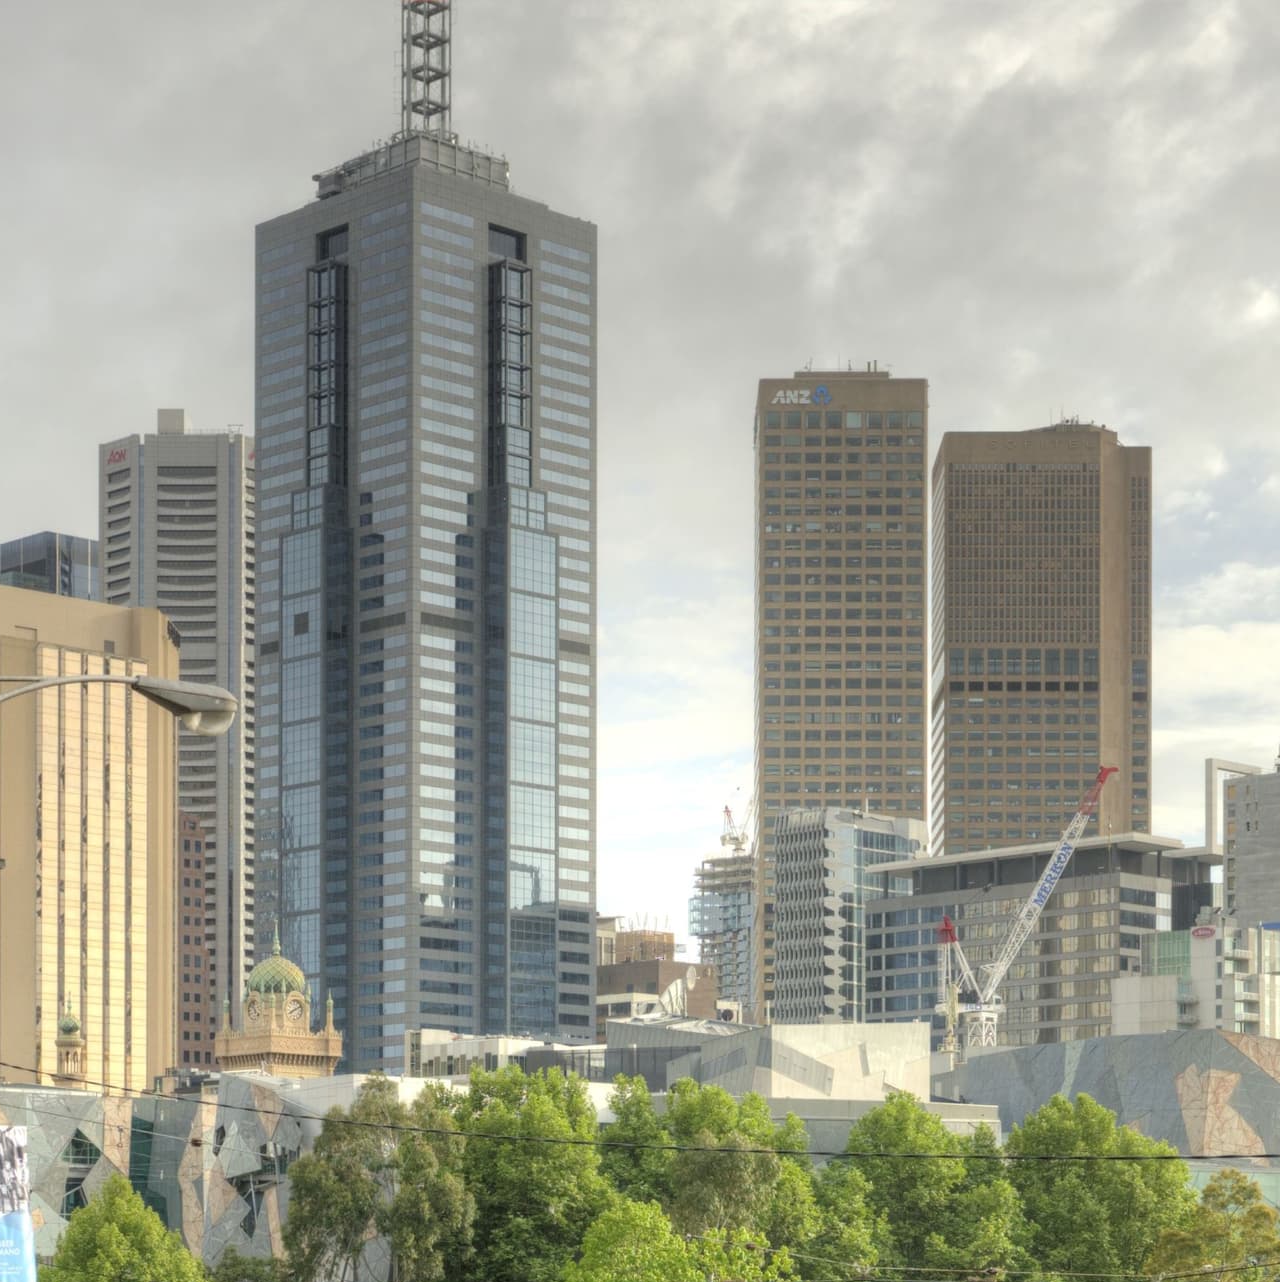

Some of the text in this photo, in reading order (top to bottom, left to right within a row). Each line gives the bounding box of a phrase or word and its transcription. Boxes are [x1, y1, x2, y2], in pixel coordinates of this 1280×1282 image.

[770, 389, 811, 405] ANZ
[991, 439, 1097, 451] SOFITEL
[1033, 842, 1073, 907] MERKON
